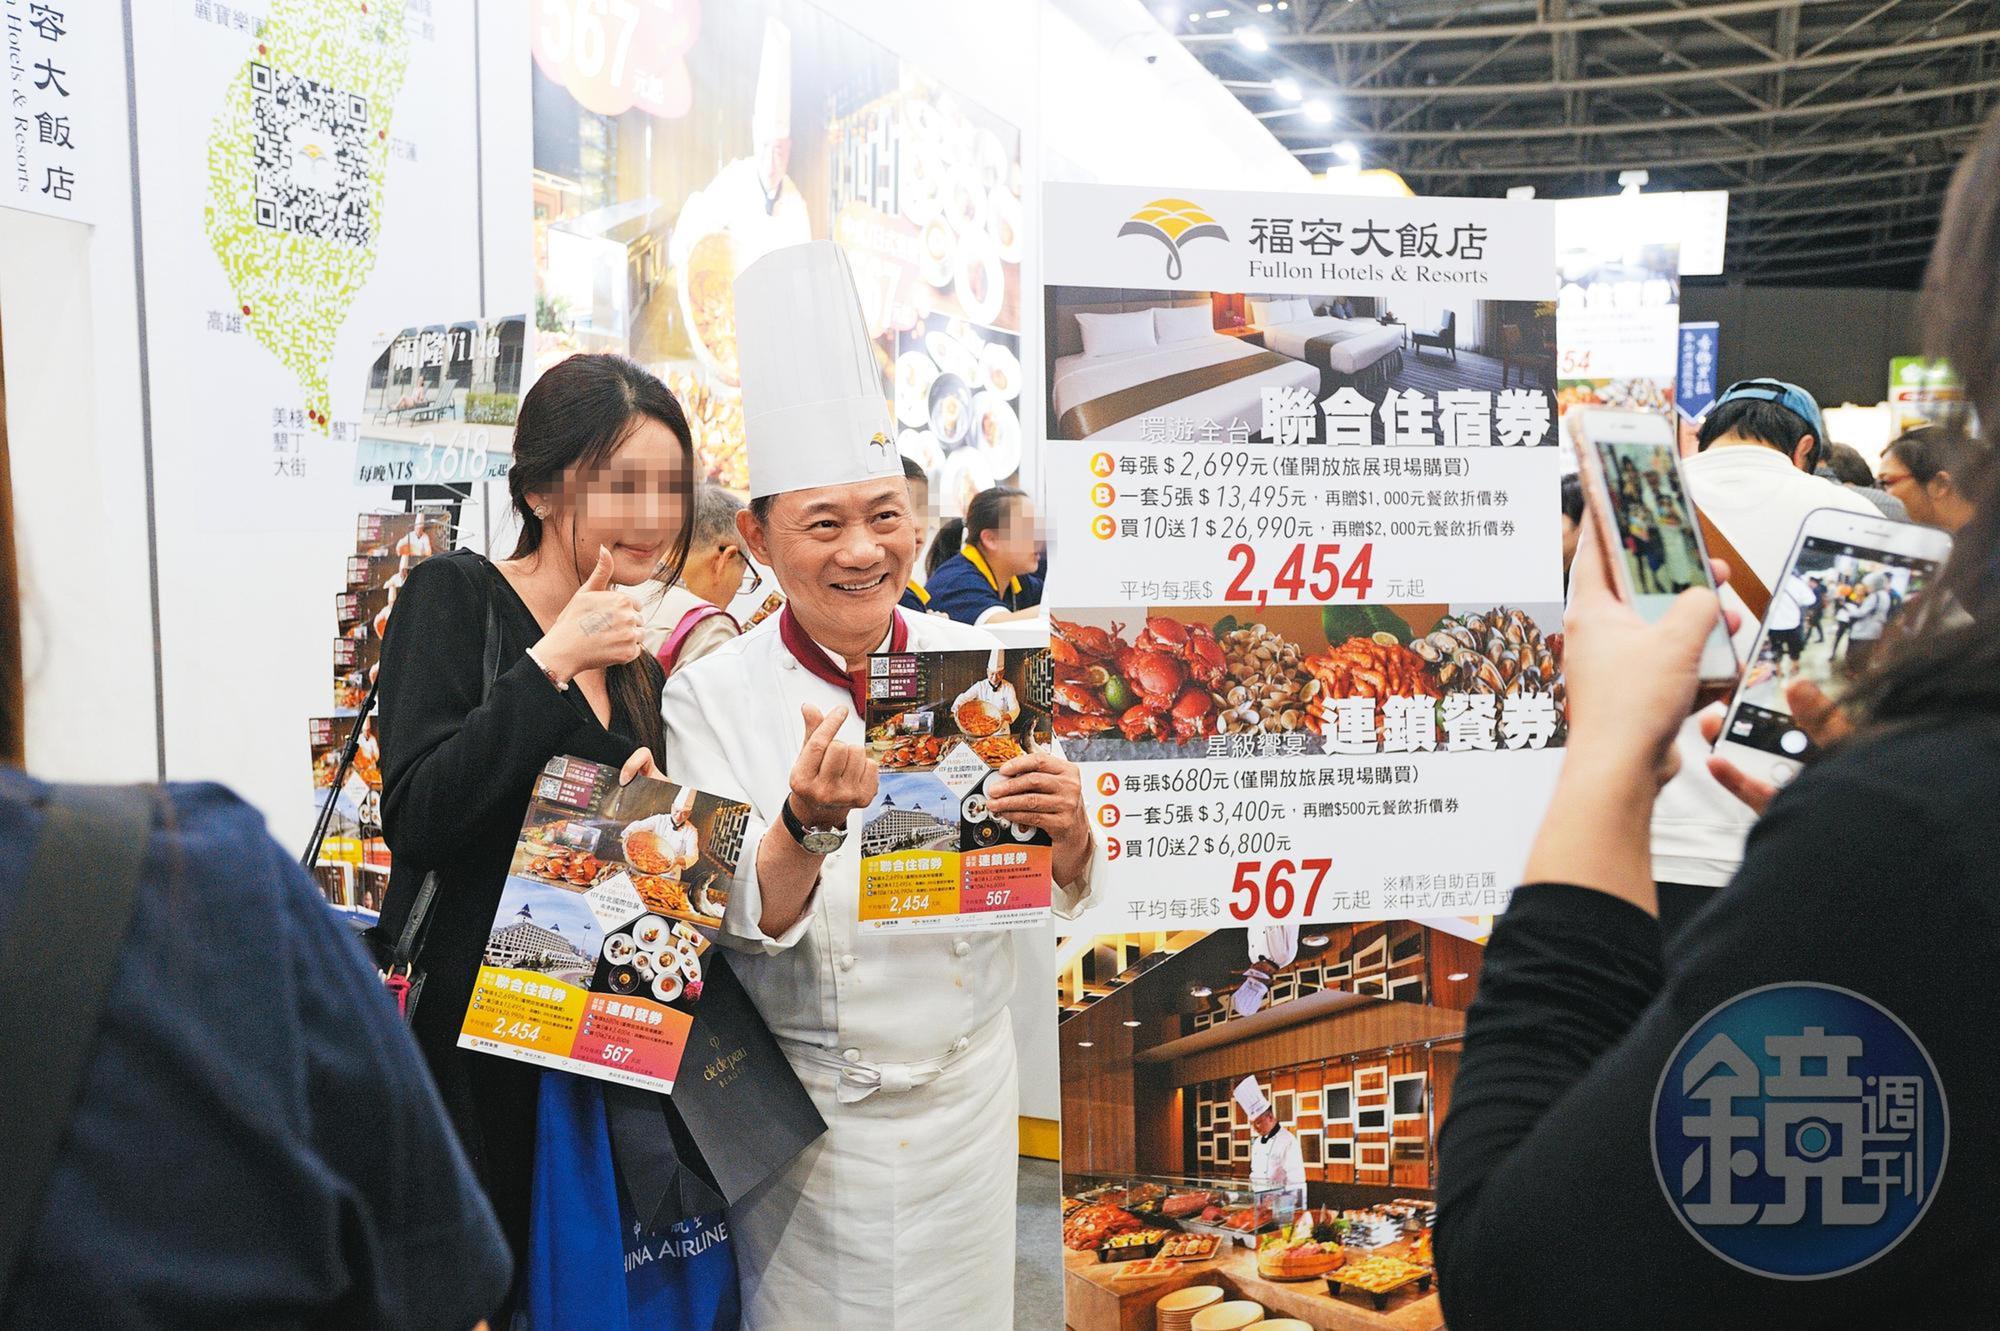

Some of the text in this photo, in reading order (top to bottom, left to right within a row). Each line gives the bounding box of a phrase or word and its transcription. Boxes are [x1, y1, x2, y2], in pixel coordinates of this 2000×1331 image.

[7, 14, 24, 81] Hotels
[13, 89, 27, 108] &
[14, 116, 31, 193] Resorts
[1248, 217, 1488, 260] 福容大飯店
[1248, 259, 1489, 284] Fullon Hotels & Resorts
[206, 309, 243, 334] 高雄
[1138, 385, 1552, 449] 環遊全台 聯合住宿券
[273, 456, 306, 478] 大街
[414, 428, 489, 482] 3,618
[1093, 454, 1112, 474] A
[1094, 485, 1112, 505] B
[1095, 519, 1113, 537] C
[1120, 542, 1426, 614] 平均每張$ 2,454 元起
[1206, 691, 1558, 759] 星級饗宴 連鎖餐券
[1100, 775, 1118, 792] A
[1101, 807, 1118, 825] B
[985, 889, 1012, 906] 567
[1127, 857, 1372, 922] 平均每張$ 567 元起
[889, 894, 930, 915] 2,454
[492, 1017, 542, 1042] 2,454
[602, 1043, 634, 1064] 567
